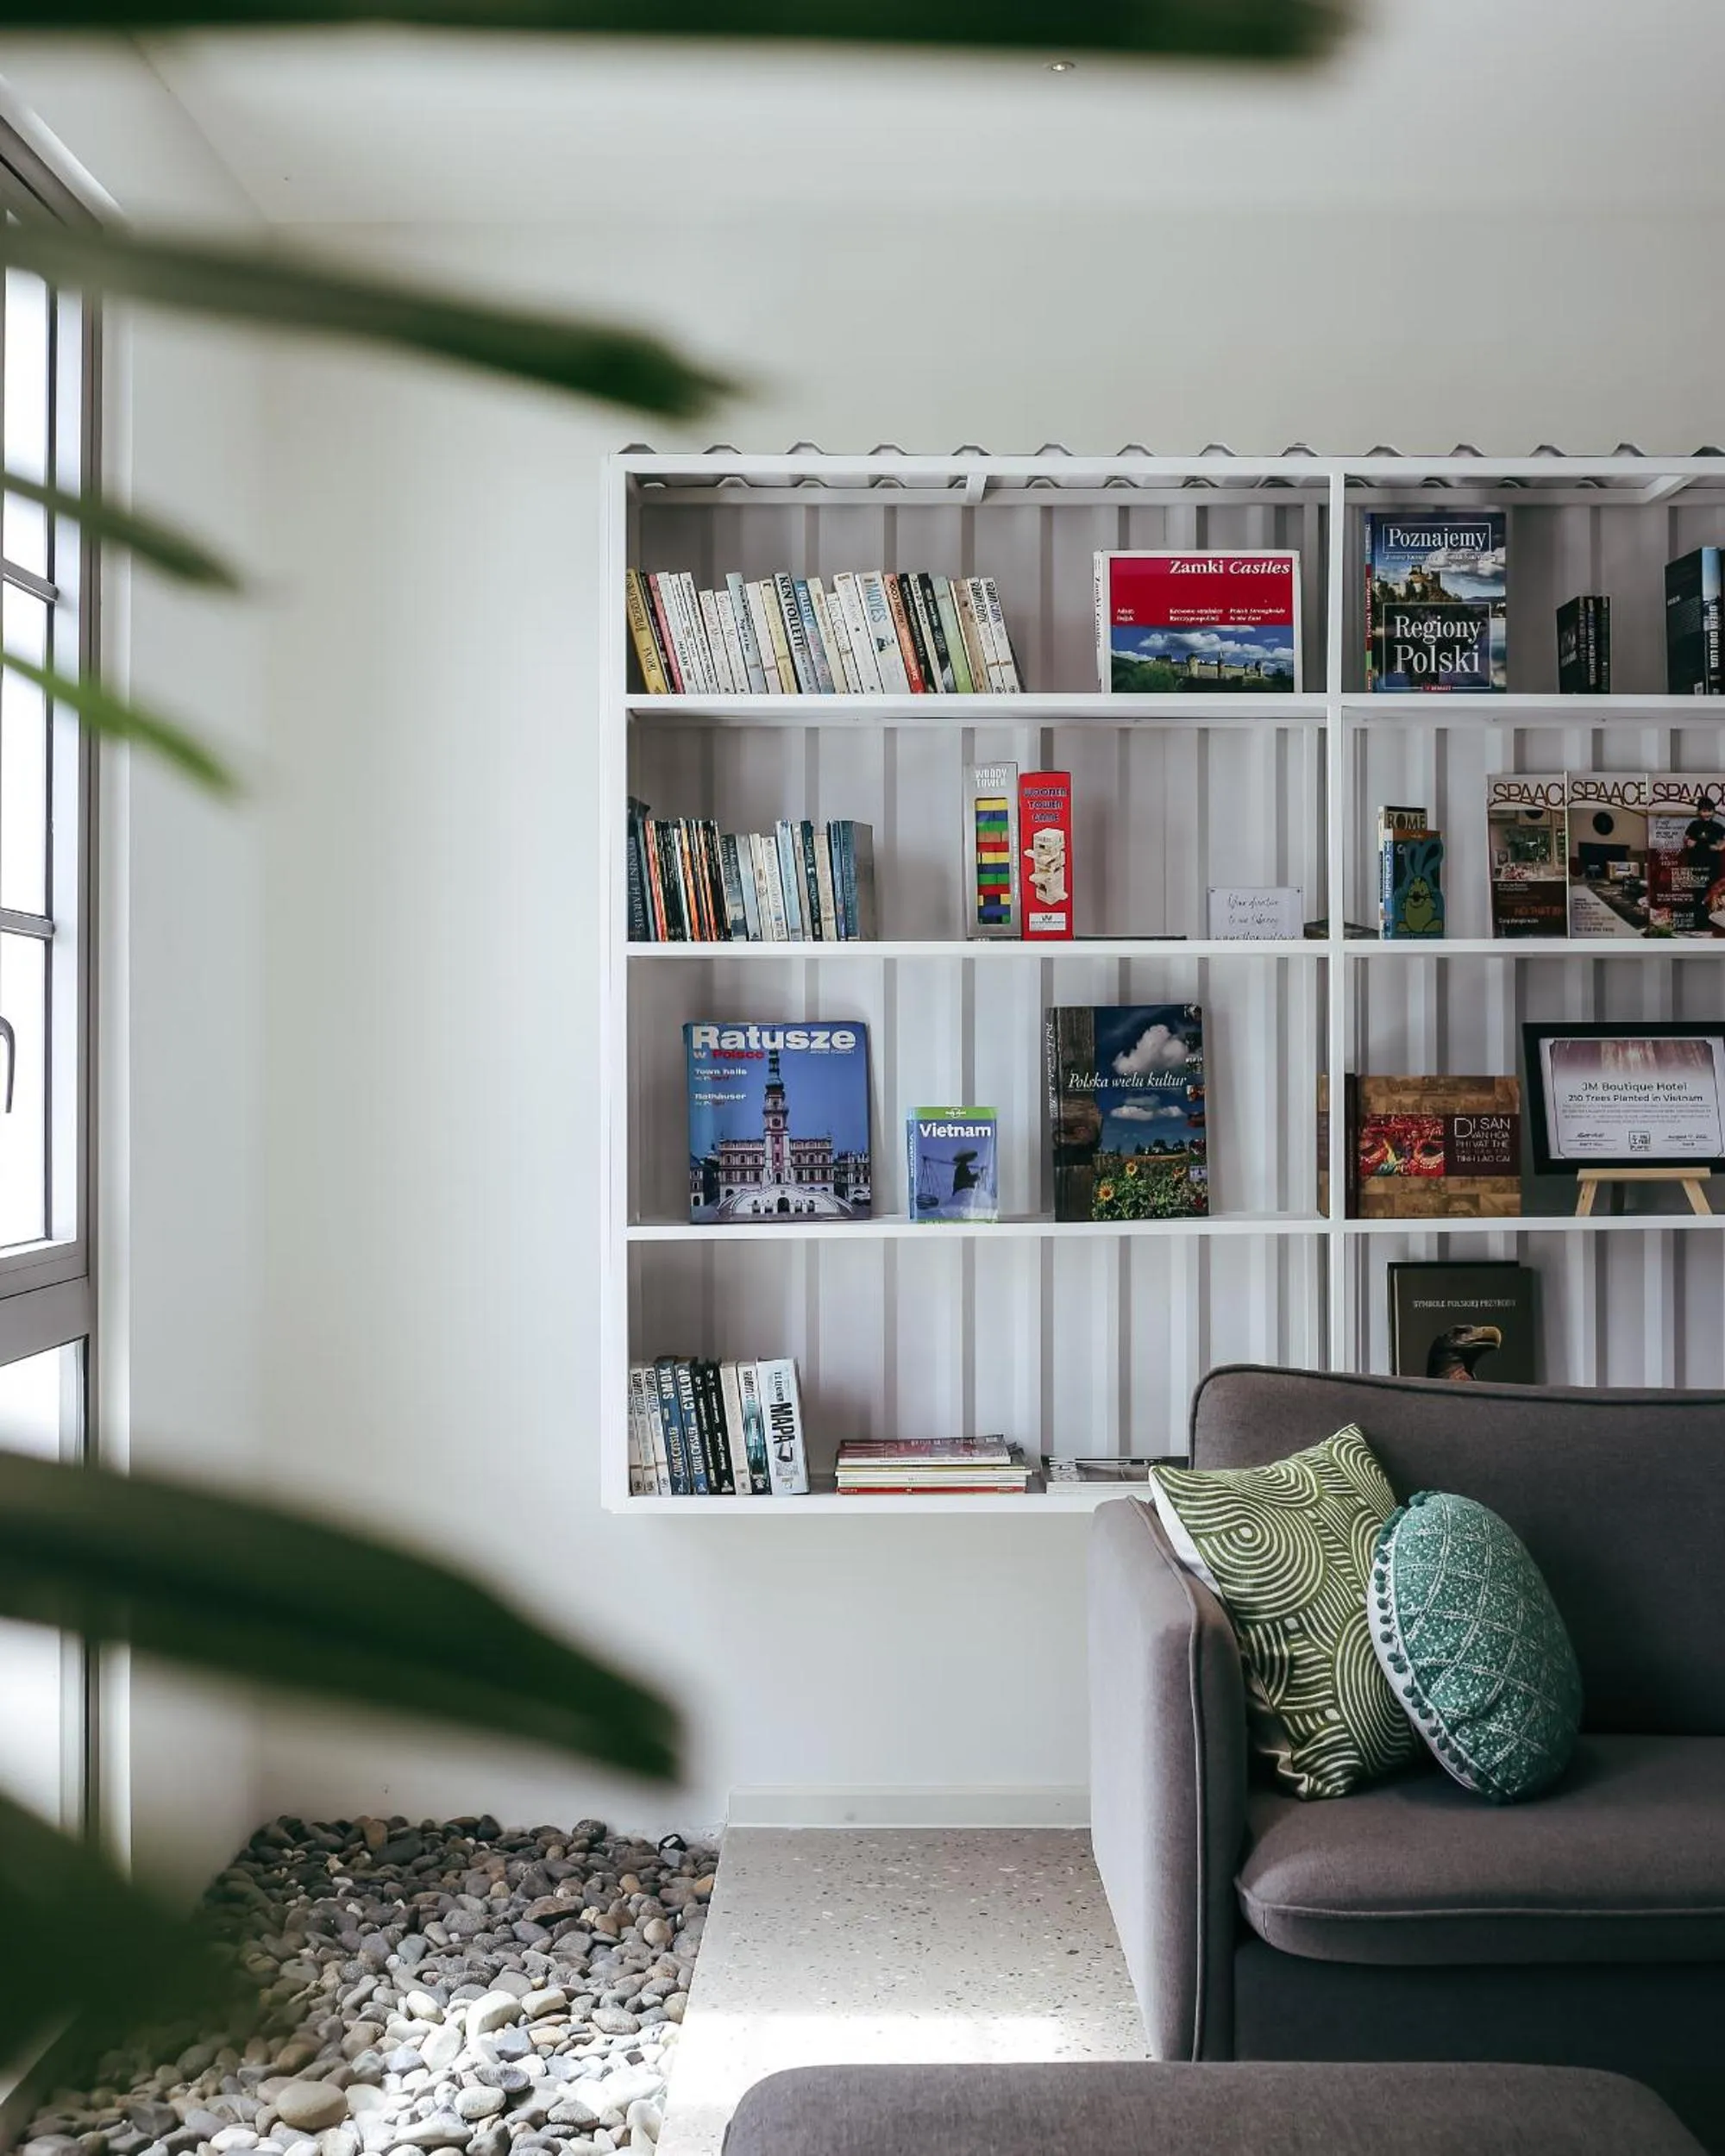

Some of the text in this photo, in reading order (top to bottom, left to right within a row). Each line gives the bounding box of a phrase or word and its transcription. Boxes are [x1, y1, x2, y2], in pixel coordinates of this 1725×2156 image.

[1388, 528, 1486, 550] Poznajemy
[1170, 560, 1290, 574] Zamki Castles
[867, 579, 887, 624] MOYES
[778, 576, 805, 650] KEN FOLLETT
[1394, 615, 1481, 644] Regiony
[1394, 644, 1482, 674] Polski
[975, 768, 1007, 779] WOODY
[976, 779, 1007, 788] TOWER
[1571, 781, 1649, 805] SPAACE
[1027, 799, 1063, 810] TOWER
[1387, 813, 1426, 829] ROME
[693, 1025, 856, 1050] Ratusze
[712, 1050, 765, 1060] Polsce
[723, 1067, 748, 1075] halls
[1069, 1071, 1187, 1088] Polska wielu kultur
[1582, 1081, 1688, 1093] JM Boutique Hotel
[1653, 1094, 1661, 1102] in
[919, 1122, 991, 1138] Vietnam
[659, 1368, 675, 1401] SMOK
[678, 1364, 695, 1411] CYKLOP
[769, 1401, 795, 1445] MAPA
